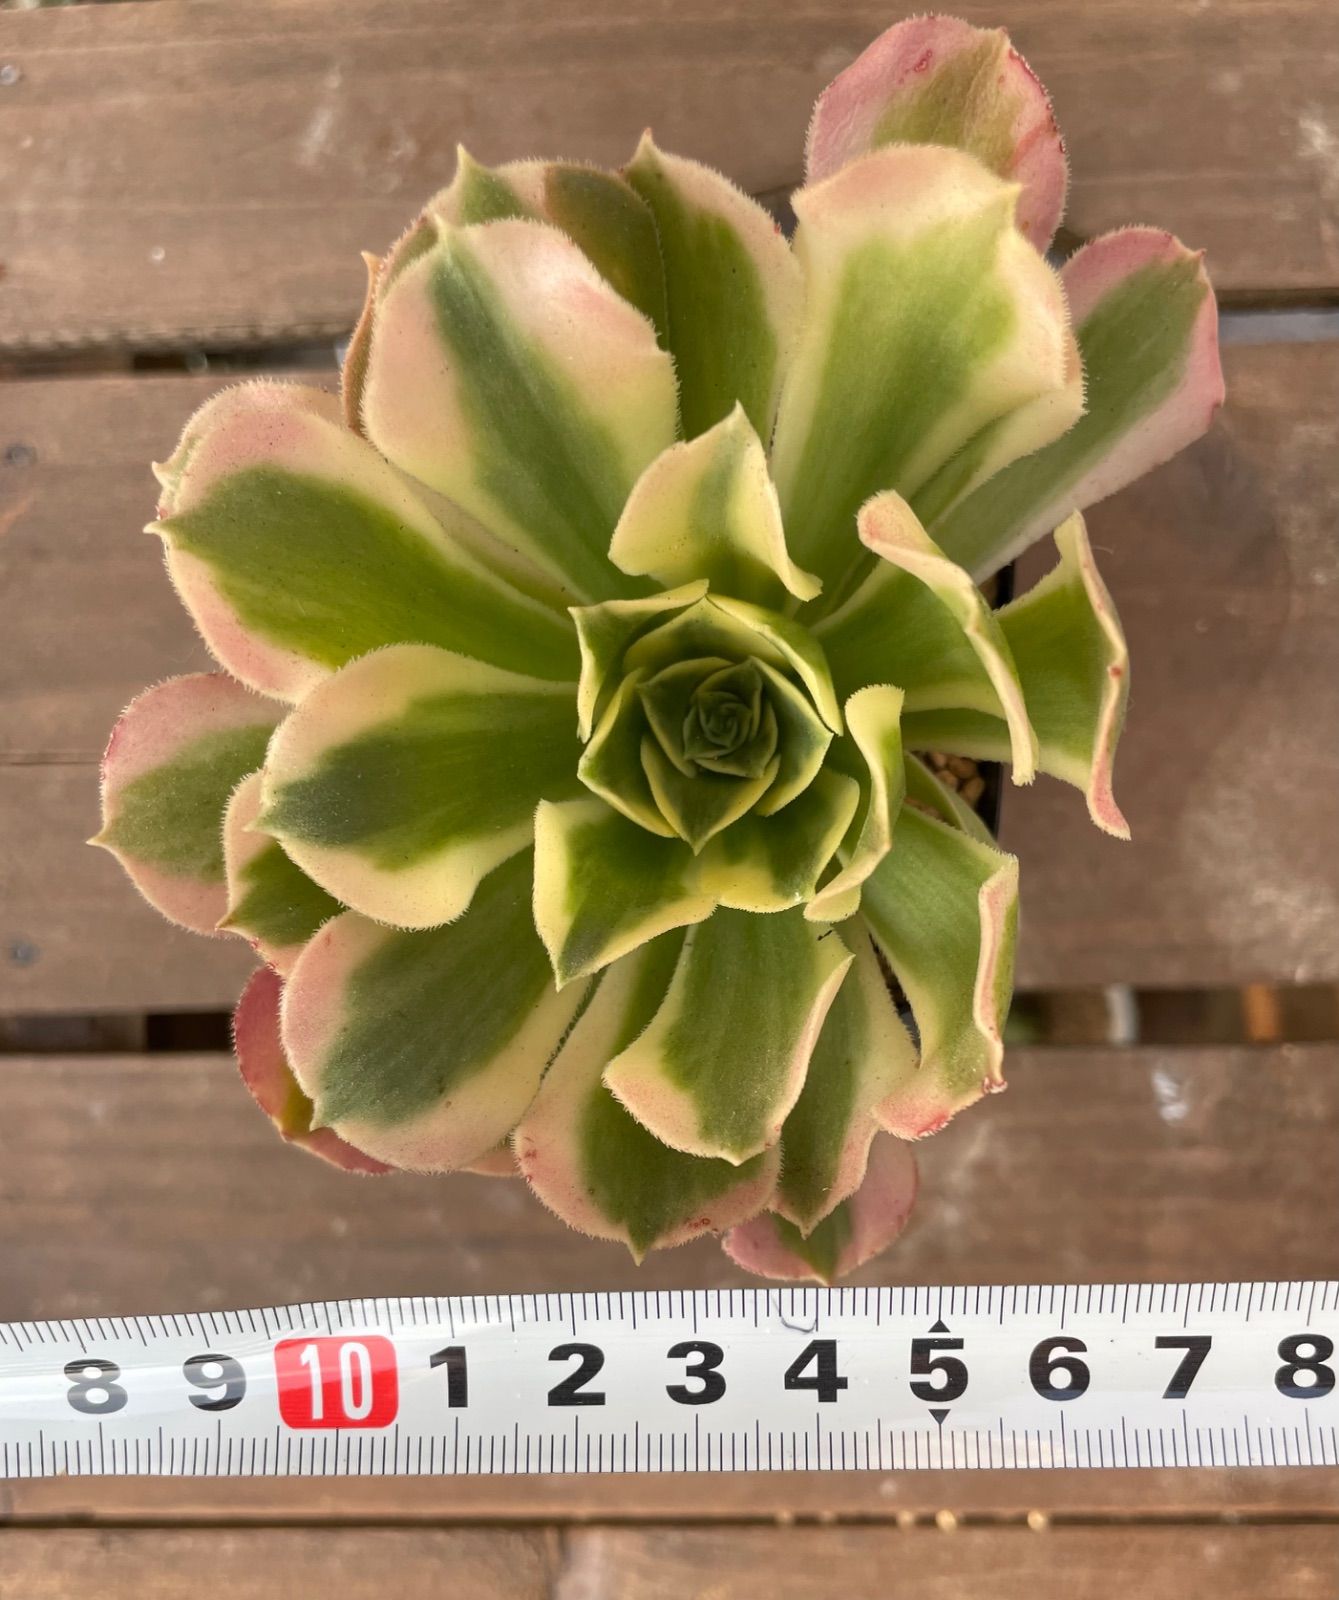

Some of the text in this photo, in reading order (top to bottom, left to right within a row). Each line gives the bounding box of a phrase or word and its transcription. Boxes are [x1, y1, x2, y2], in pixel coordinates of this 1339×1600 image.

[63, 1334, 1336, 1421] 8 9 10 1 2 3 4 5 6 7 8
